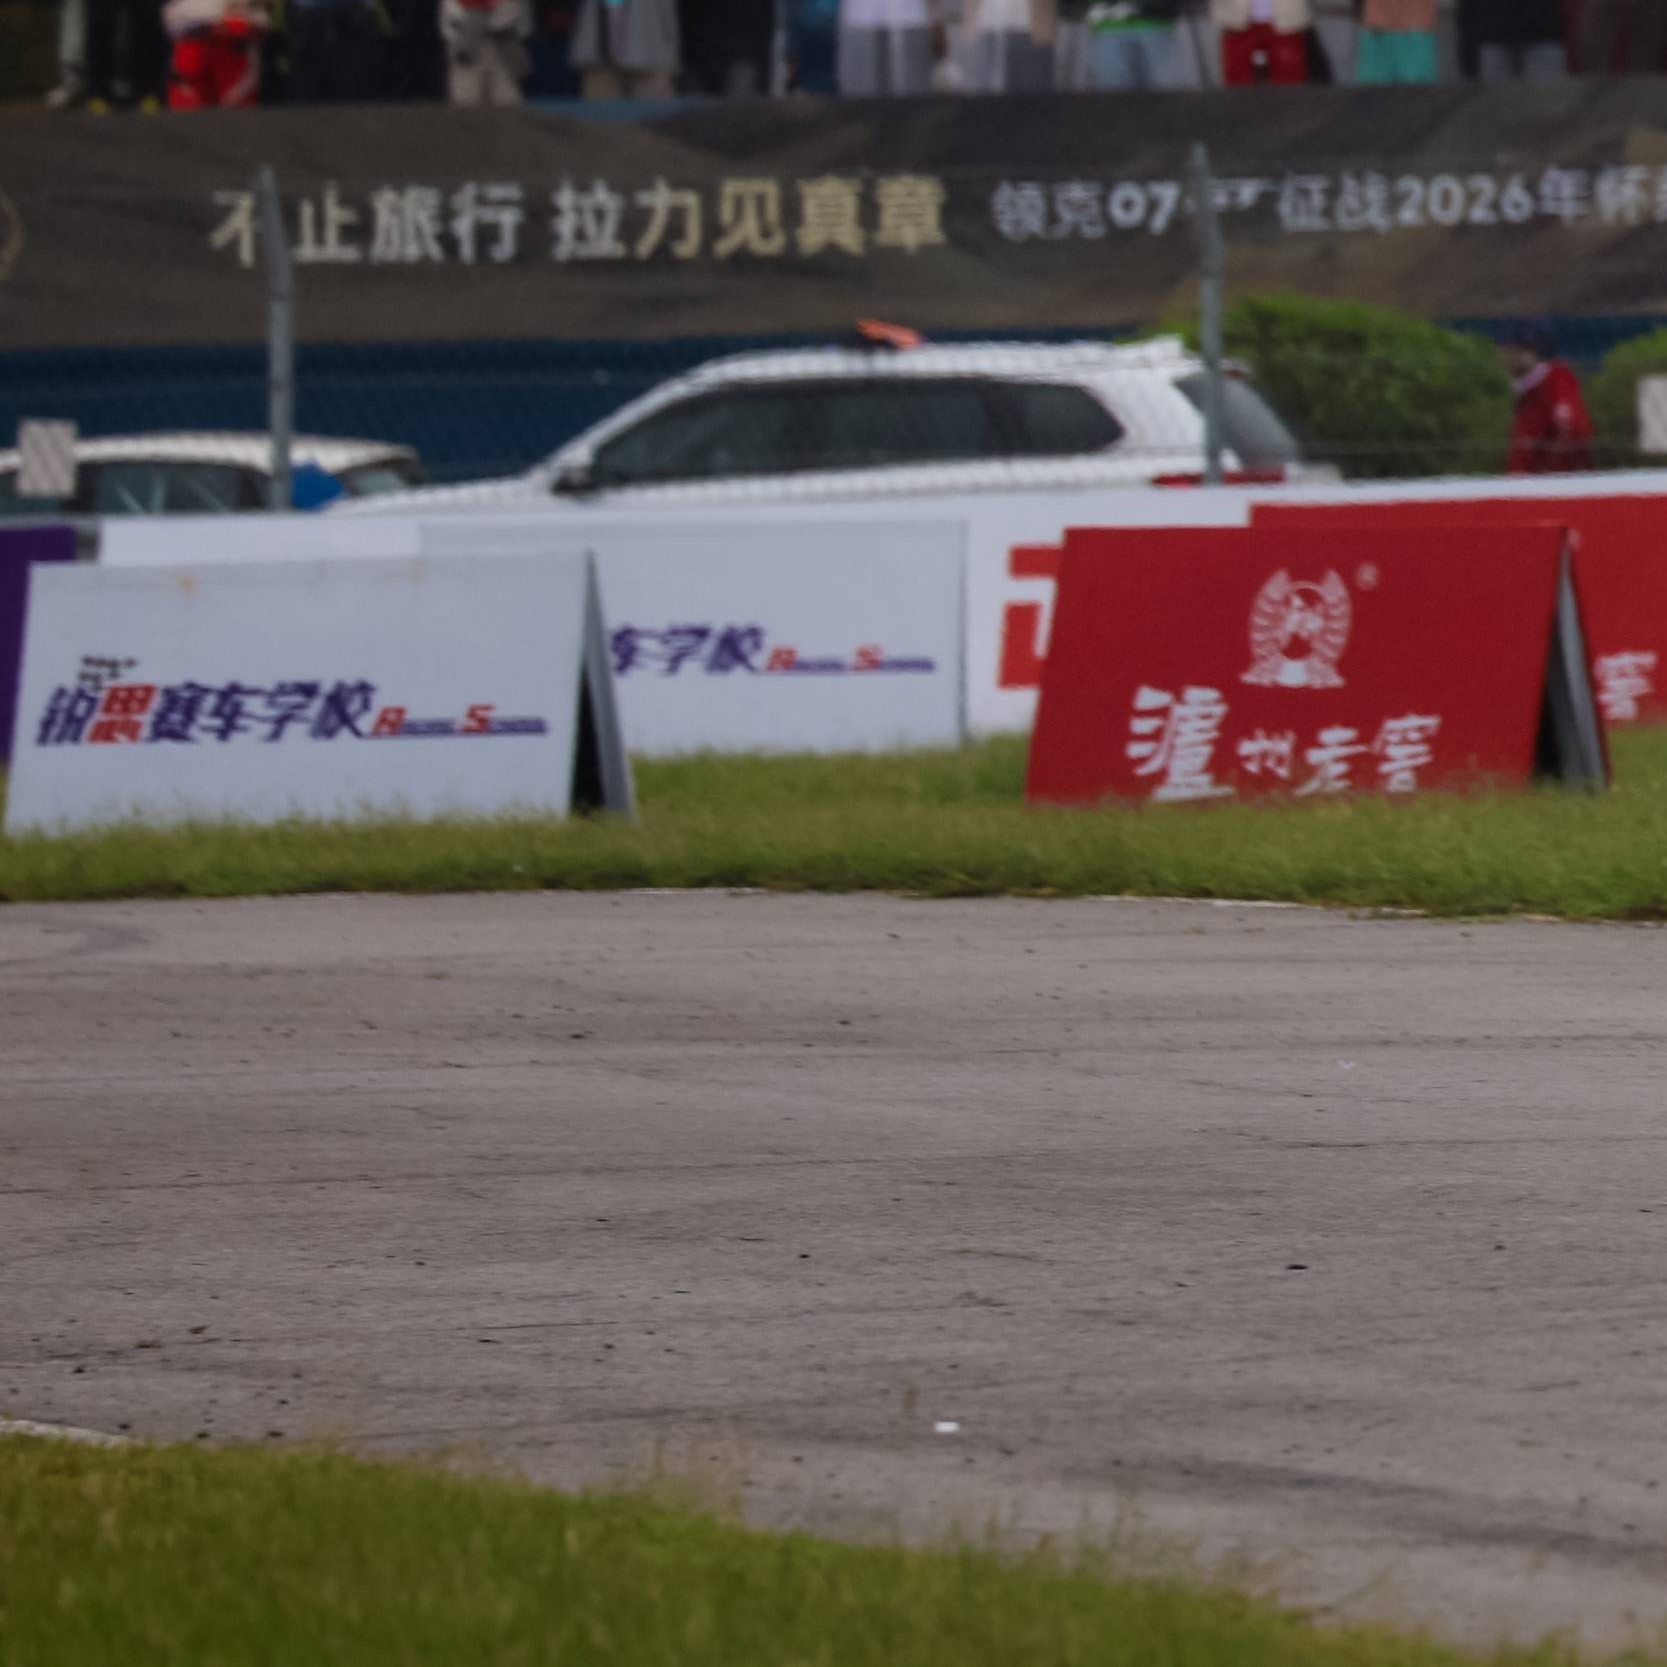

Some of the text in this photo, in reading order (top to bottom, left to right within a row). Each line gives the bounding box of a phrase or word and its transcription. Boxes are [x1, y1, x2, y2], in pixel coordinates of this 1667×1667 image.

[206, 172, 948, 267] 不止旅行 拉力见真章
[1126, 685, 1442, 802] 泸州老窖
